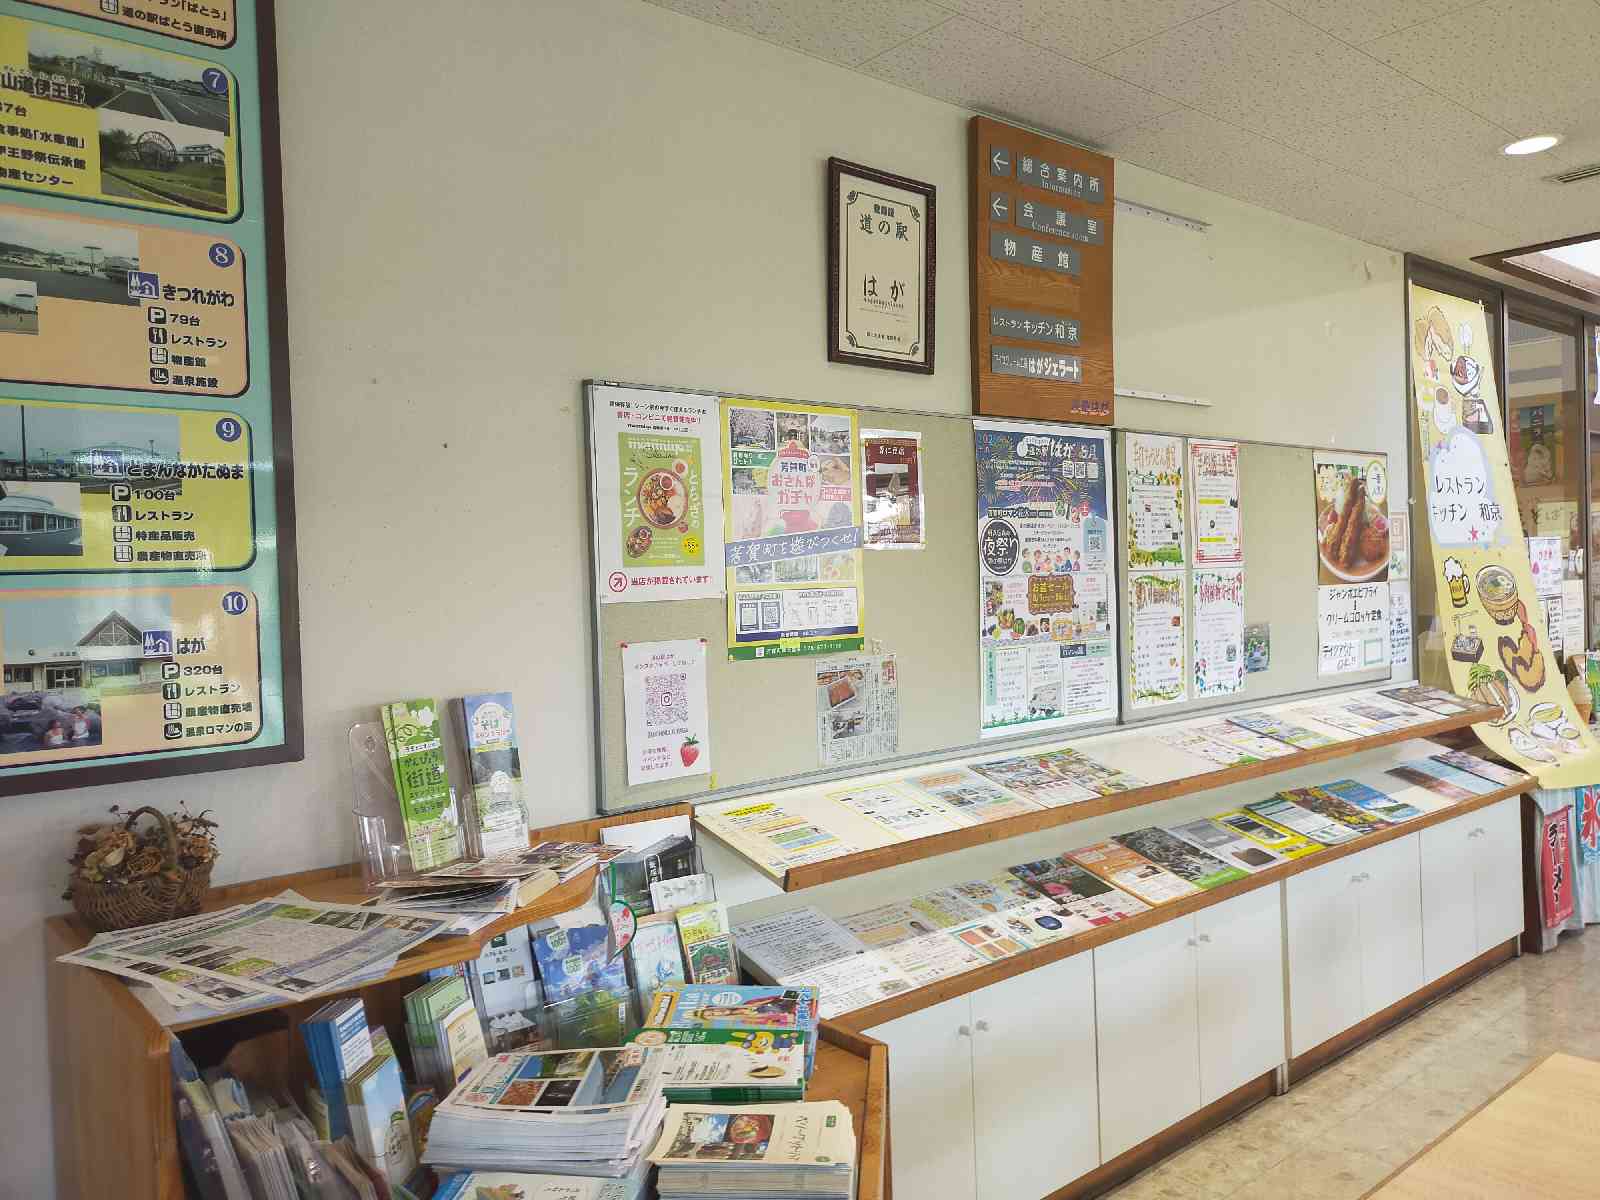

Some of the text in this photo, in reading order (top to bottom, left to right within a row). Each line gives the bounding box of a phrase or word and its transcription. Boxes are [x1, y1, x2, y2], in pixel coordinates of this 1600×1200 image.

[207, 71, 221, 89] 7
[859, 213, 909, 242] 道の駅
[1023, 202, 1097, 236] 会議室
[215, 246, 228, 265] 8
[1003, 237, 1070, 270] 物産館
[162, 284, 235, 308] きつれがわ
[863, 273, 906, 302] はが
[170, 313, 201, 327] 79台
[171, 334, 228, 349] レストラン
[1028, 356, 1079, 380] はがジェラート
[172, 375, 219, 389] 温泉施設
[221, 421, 235, 438] 9
[127, 463, 244, 480] どまんなかたぬま
[1435, 474, 1485, 496] レストラン
[133, 489, 176, 501] 100台
[623, 467, 641, 528] ランチ
[135, 510, 194, 522] レストラン
[1432, 503, 1503, 523] キッチン 和京
[135, 531, 196, 542] 特産品販売
[224, 594, 247, 613] 10
[176, 637, 207, 655] はが
[183, 664, 223, 676] 320台
[185, 684, 241, 697] レストラン
